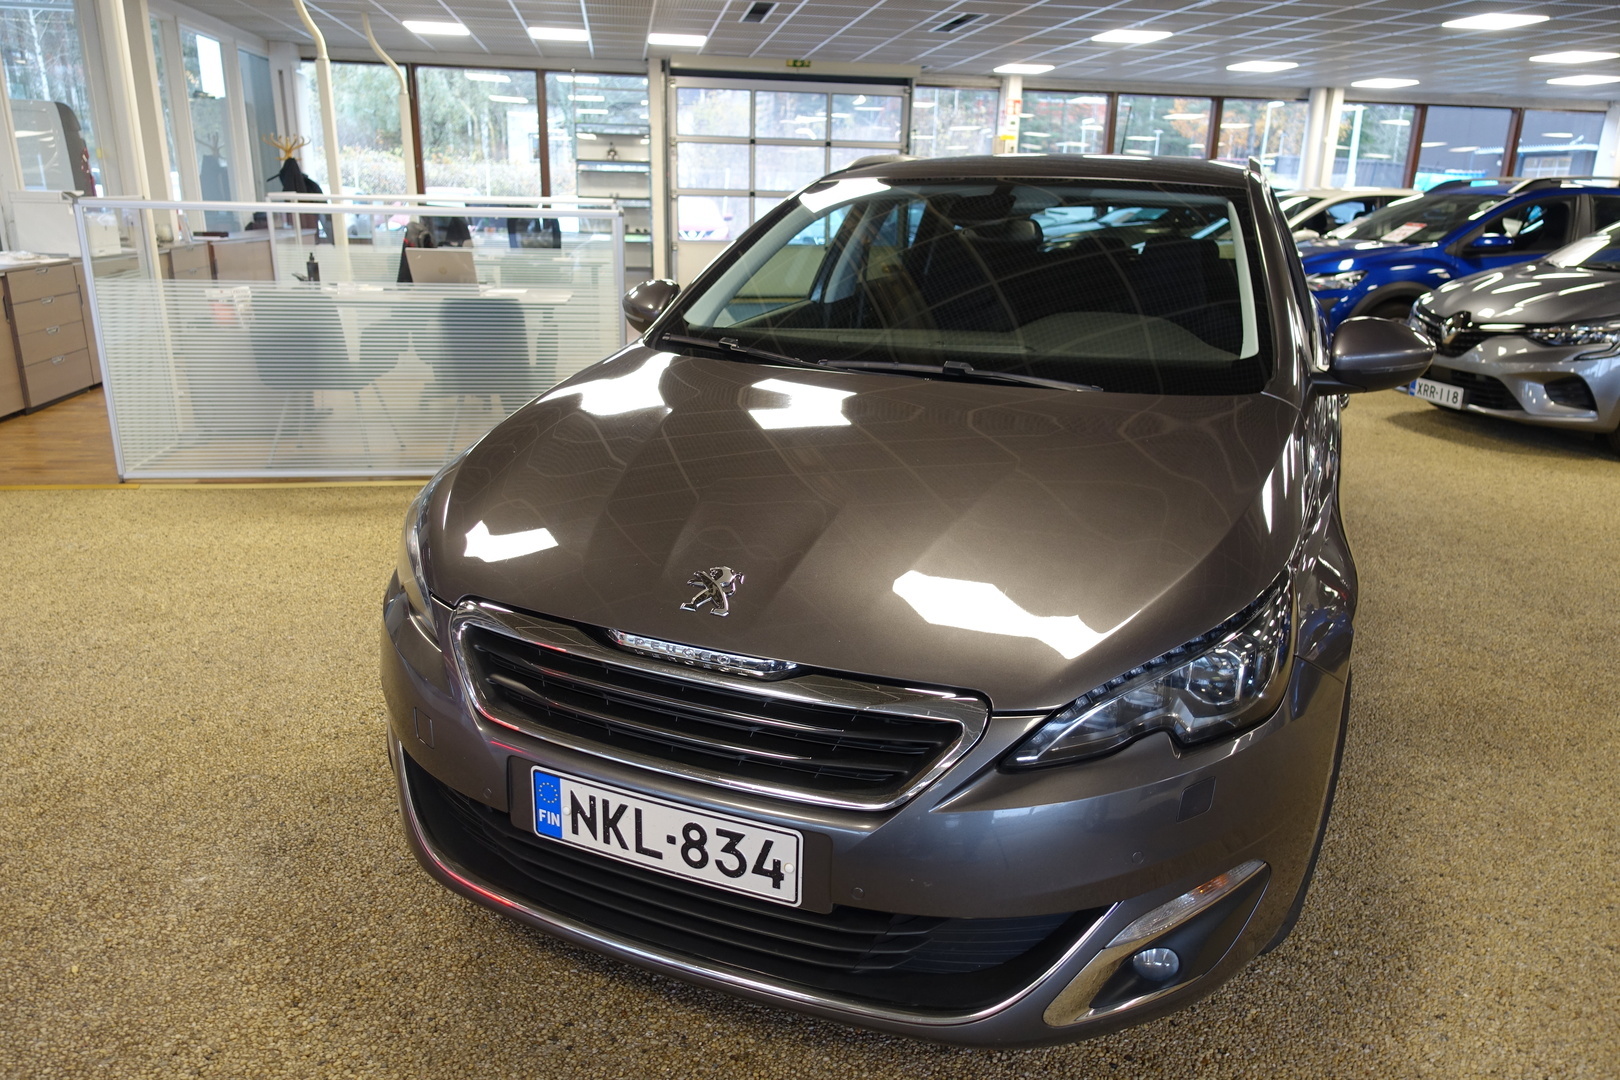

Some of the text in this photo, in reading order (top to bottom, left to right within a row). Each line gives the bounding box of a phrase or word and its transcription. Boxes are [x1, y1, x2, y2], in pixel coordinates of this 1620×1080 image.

[1417, 382, 1459, 404] XRR-118
[634, 636, 747, 667] PEUGEOT
[539, 808, 560, 827] FIN
[570, 789, 784, 890] NKL-834
